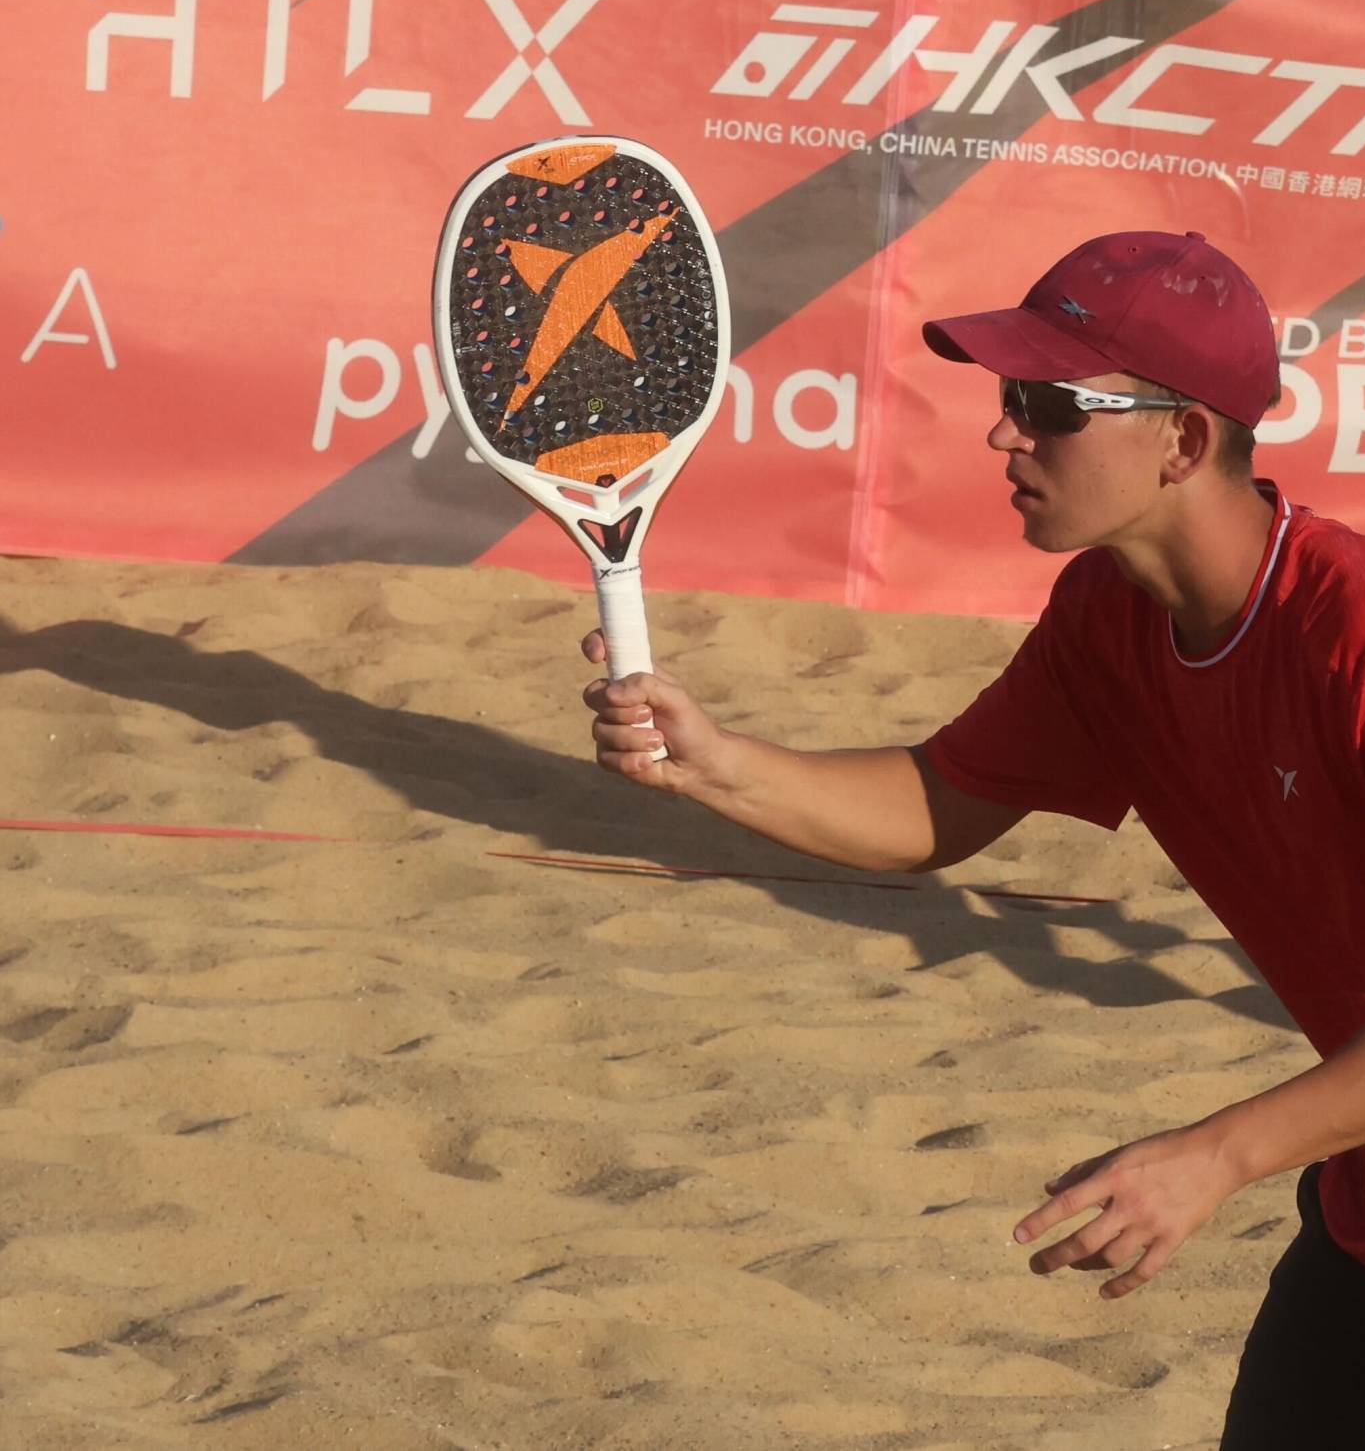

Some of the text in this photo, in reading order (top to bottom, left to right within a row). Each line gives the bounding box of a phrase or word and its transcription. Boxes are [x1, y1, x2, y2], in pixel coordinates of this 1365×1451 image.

[703, 118, 1227, 181] HONG KONG, CHINA TENNIS ASSOCIATION
